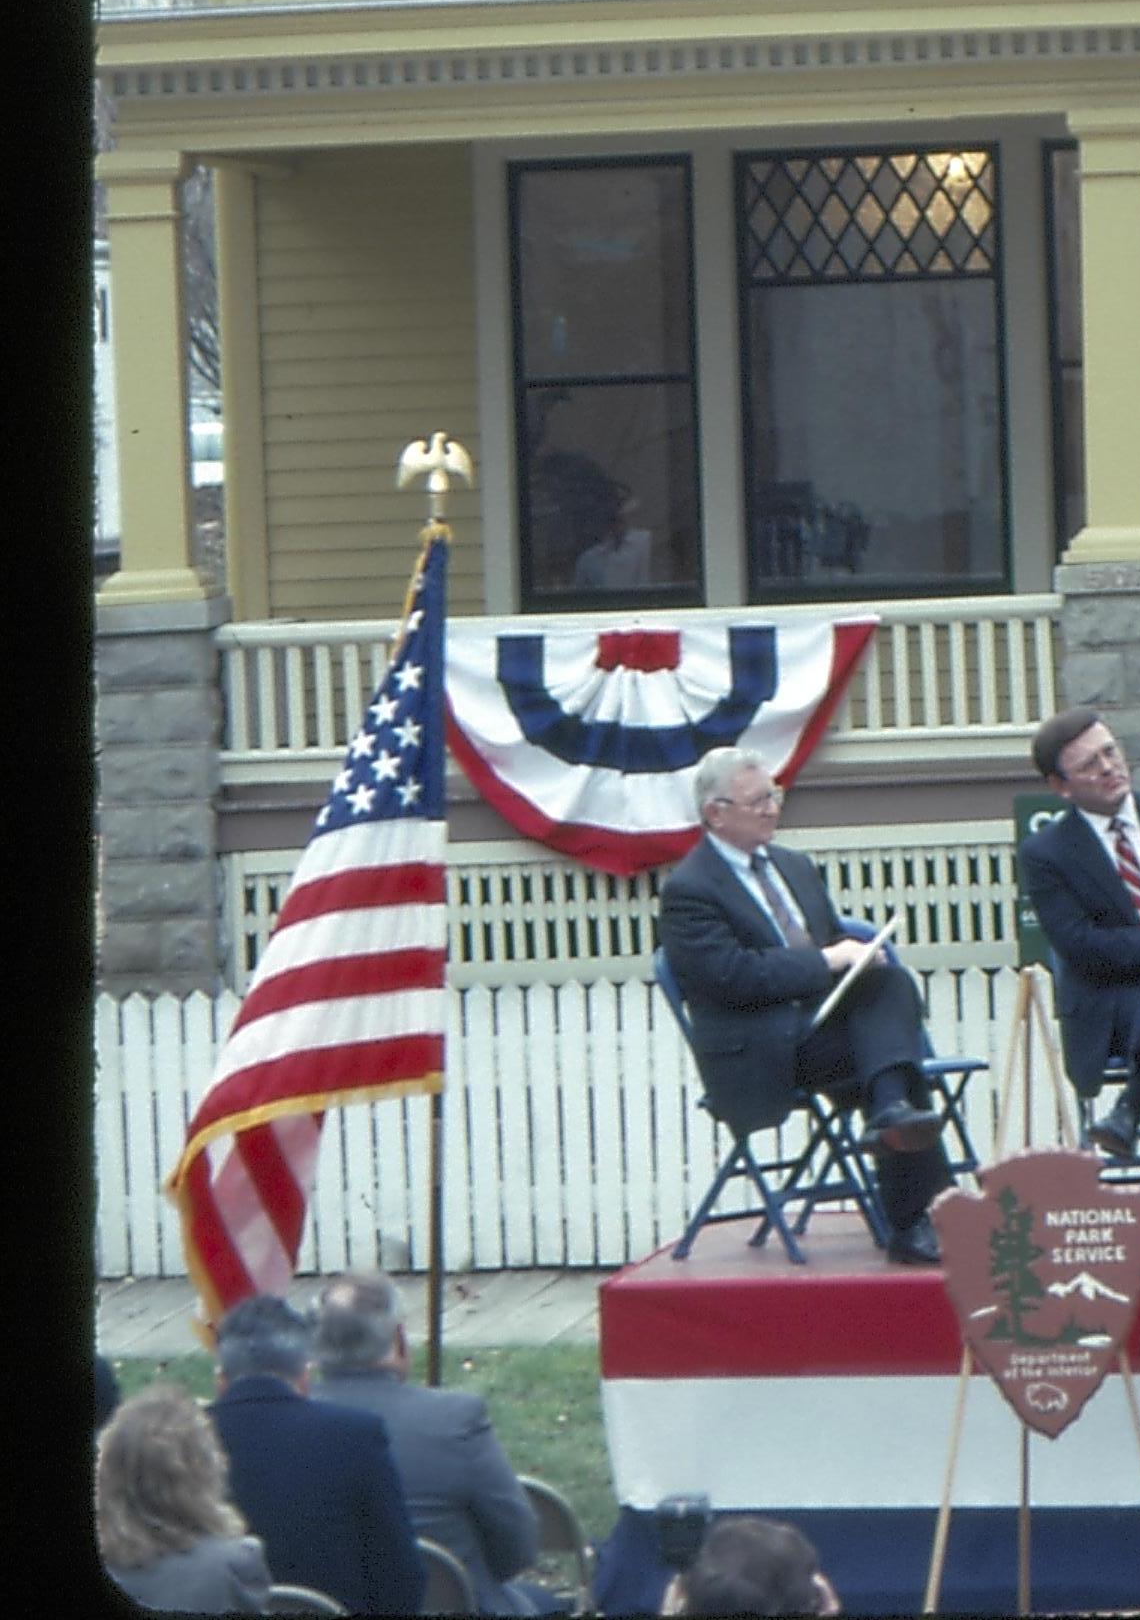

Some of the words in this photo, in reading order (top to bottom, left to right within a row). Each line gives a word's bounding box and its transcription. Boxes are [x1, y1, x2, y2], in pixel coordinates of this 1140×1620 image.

[1046, 1208, 1136, 1227] NATIONAL
[1065, 1228, 1113, 1244] PARK
[1051, 1245, 1126, 1264] SERVICE
[1010, 1352, 1090, 1365] Department
